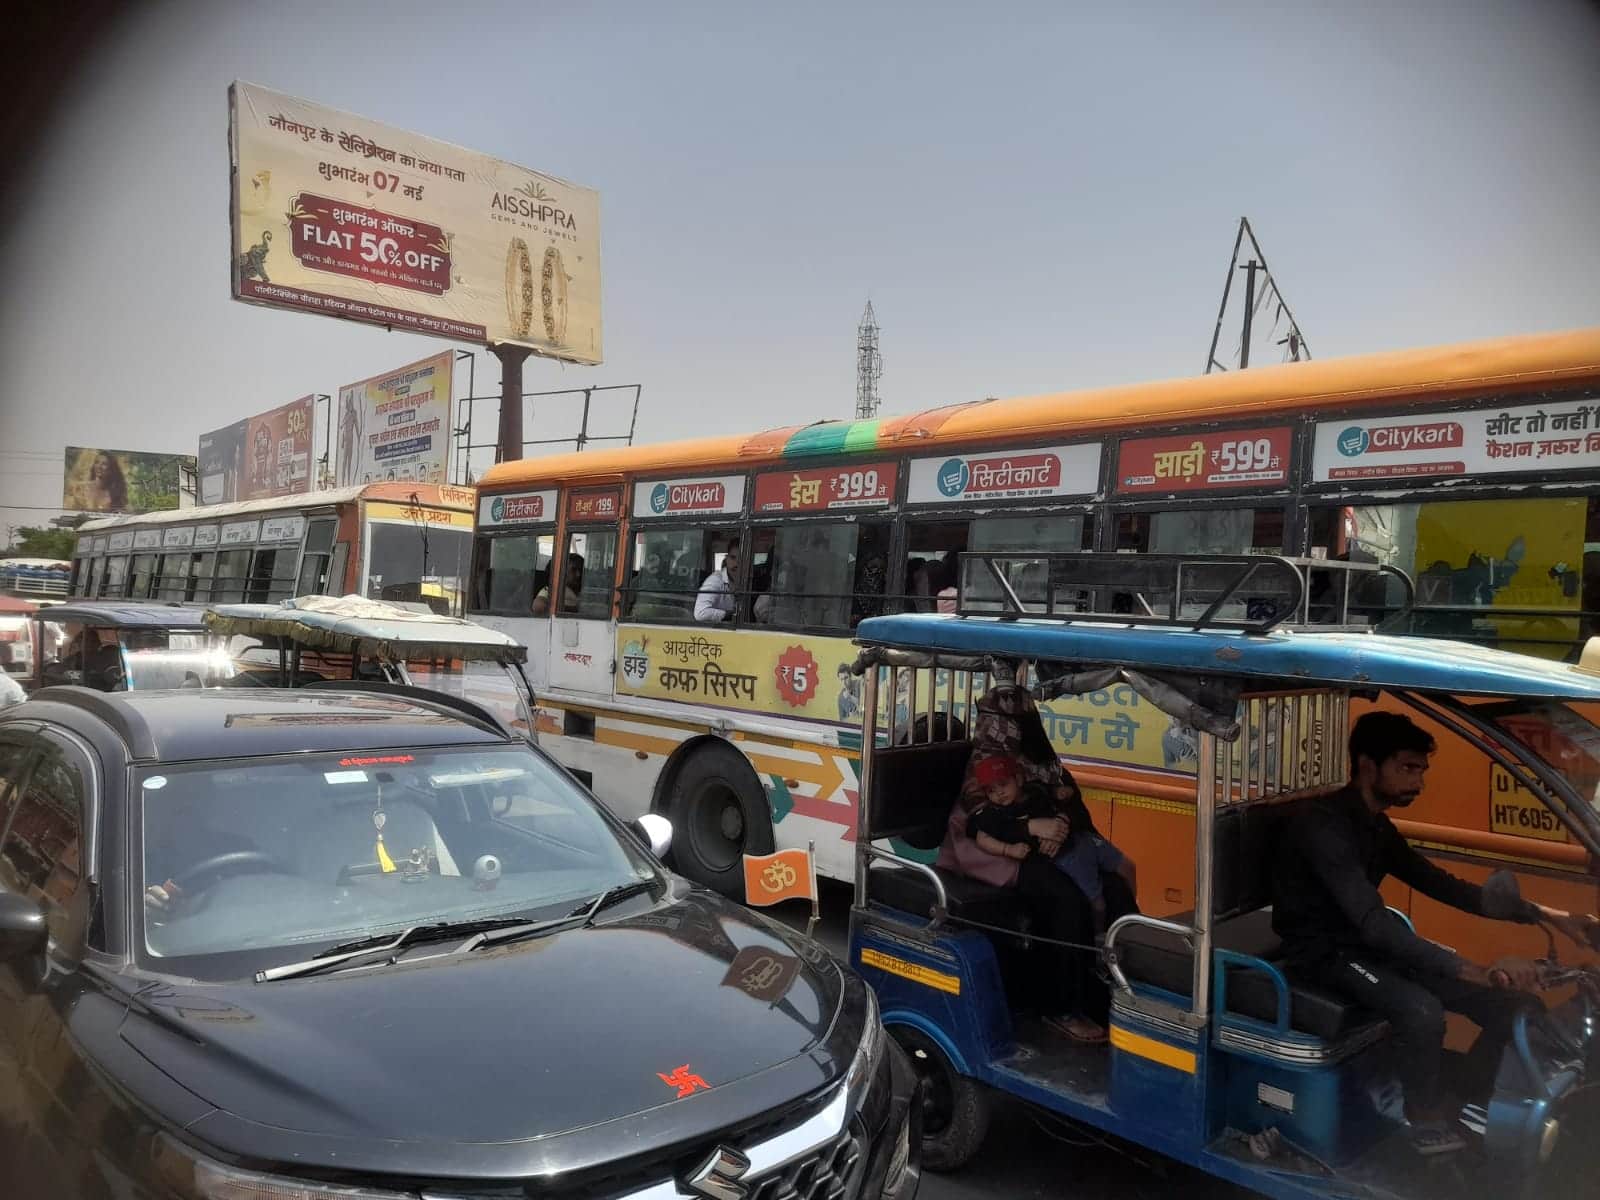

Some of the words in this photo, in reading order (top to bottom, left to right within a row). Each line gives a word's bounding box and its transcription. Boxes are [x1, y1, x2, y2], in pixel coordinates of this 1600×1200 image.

[320, 127, 335, 143] के
[399, 154, 417, 169] का
[418, 158, 443, 177] नया
[444, 167, 466, 183] पता
[318, 161, 370, 187] शुभारंभ
[373, 170, 400, 194] 07
[403, 183, 425, 201] मई
[332, 207, 379, 230] शुभारंभ
[491, 191, 577, 232] AISSHPRA
[303, 223, 356, 251] FLAT
[359, 231, 403, 267] 50%
[1372, 424, 1455, 449] Citykart
[1485, 412, 1523, 436] सीट
[1525, 409, 1549, 433] तो
[1550, 405, 1594, 431] नहीं
[971, 456, 1053, 488] सिटीकार्ट
[1153, 441, 1206, 483] साड़ी
[671, 483, 720, 508] Citykart
[662, 636, 724, 663] आयुर्वेदिक
[702, 661, 758, 701] सिरप
[1100, 711, 1141, 751] से
